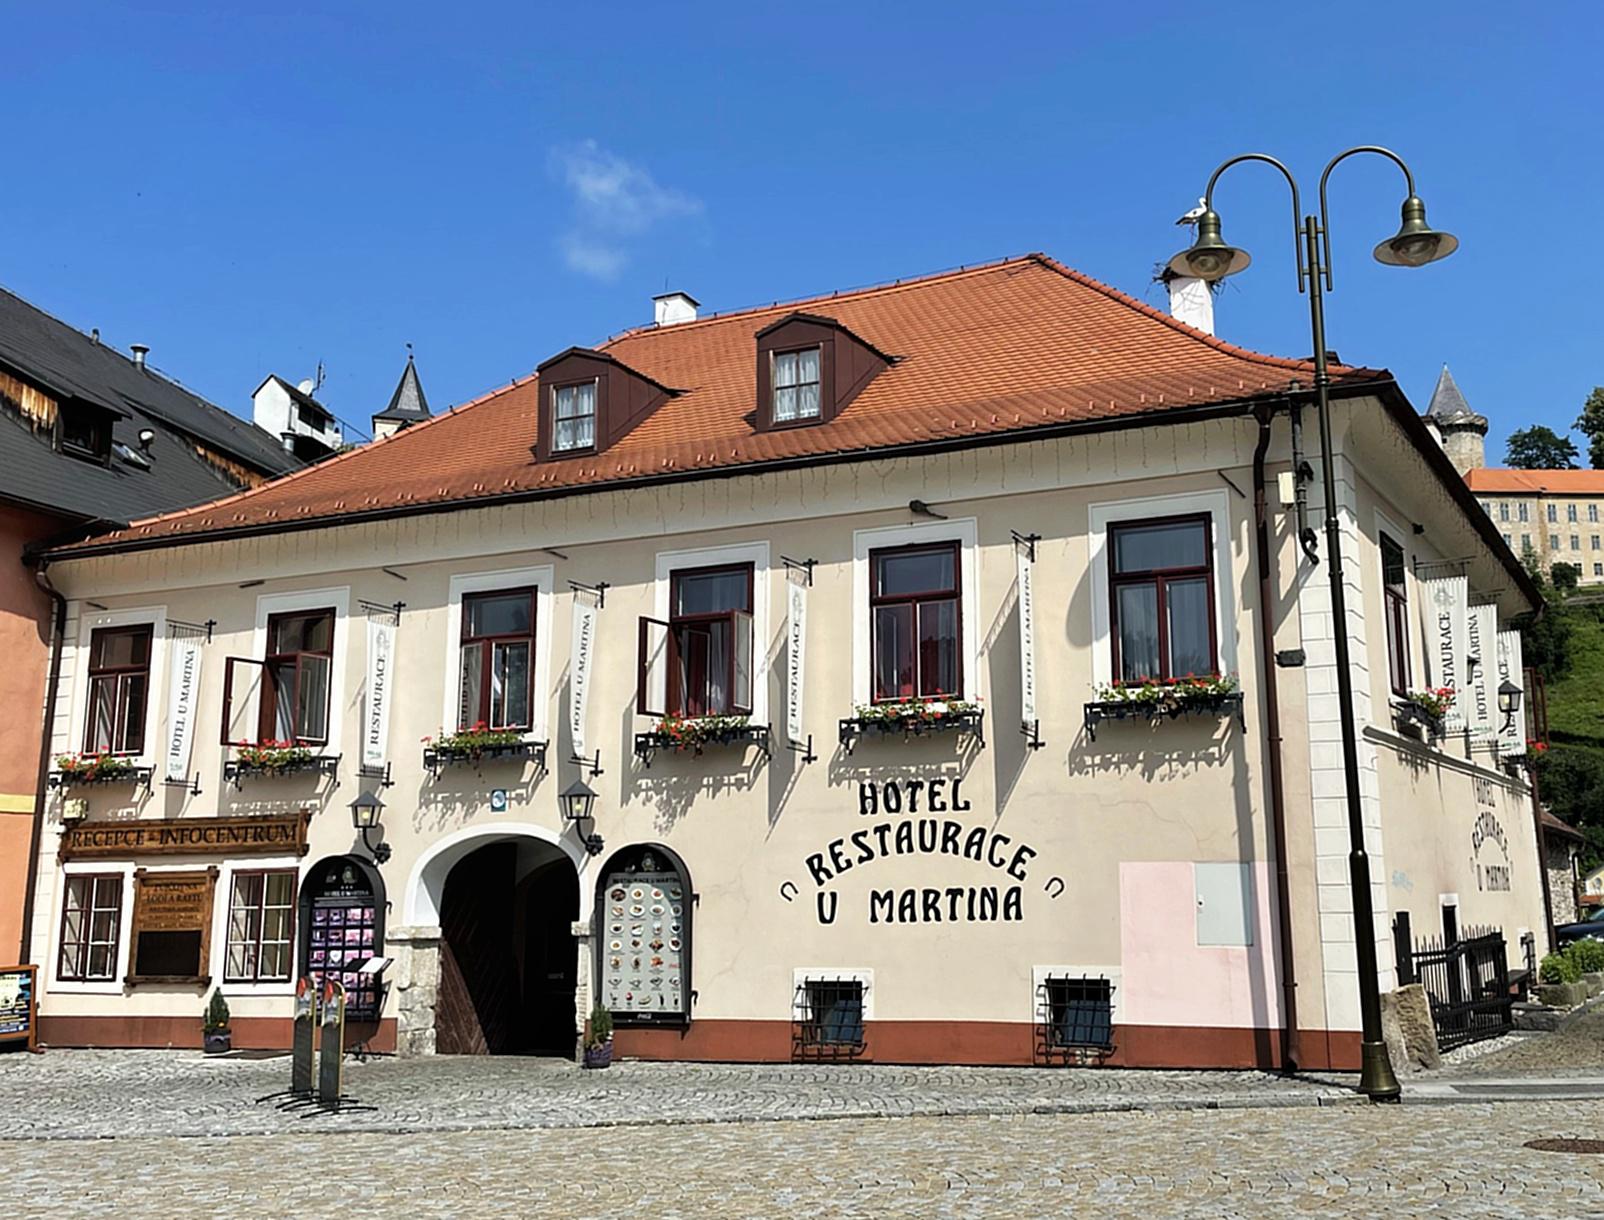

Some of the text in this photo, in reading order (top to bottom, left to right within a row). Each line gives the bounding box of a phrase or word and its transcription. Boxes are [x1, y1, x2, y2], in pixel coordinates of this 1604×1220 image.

[578, 614, 591, 673] MARTINA
[1438, 611, 1457, 706] RSTAURACE
[180, 650, 195, 704] MARTINA
[577, 675, 584, 686] U
[790, 622, 801, 719] RESTAURACE
[1474, 670, 1483, 680] U
[178, 704, 188, 715] U
[370, 654, 386, 745] RESTAURACE
[1474, 680, 1488, 721] HOTEL
[170, 717, 186, 757] HOTEL
[859, 779, 970, 815] HOTEL
[71, 829, 145, 848] RECEPCE
[158, 824, 298, 845] INFOCENTRUM
[805, 819, 1037, 887] RESTAURACE
[817, 886, 1023, 925] U MARTINA
